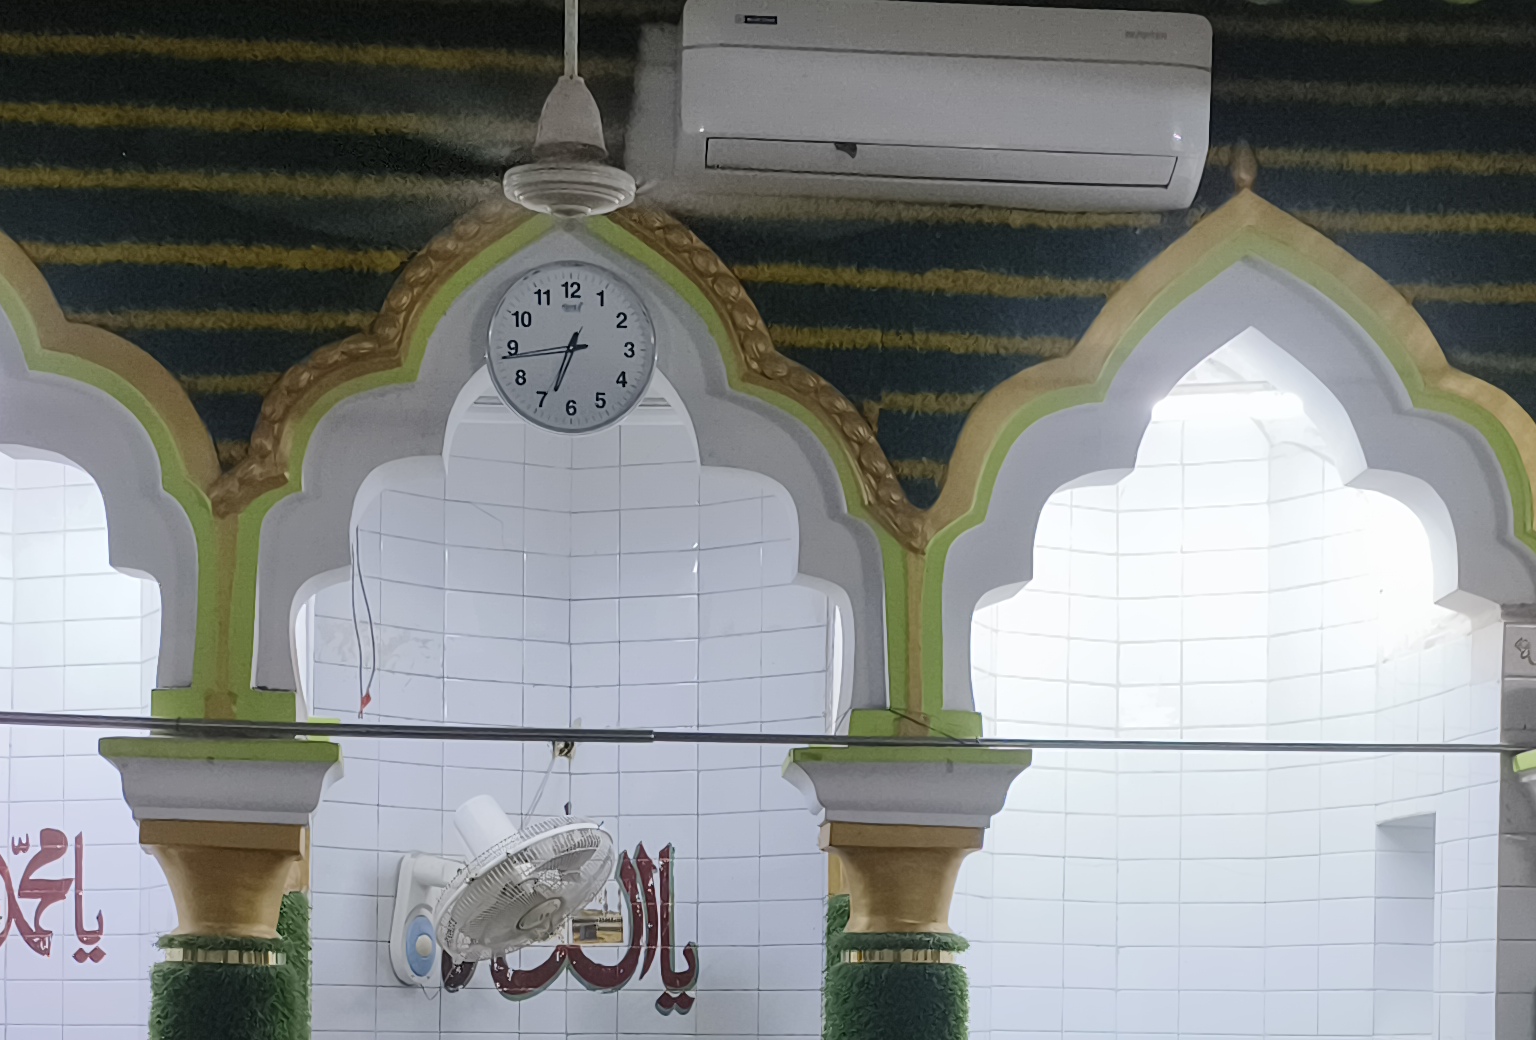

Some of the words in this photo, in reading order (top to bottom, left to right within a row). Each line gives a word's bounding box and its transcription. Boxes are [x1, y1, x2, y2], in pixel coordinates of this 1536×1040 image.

[534, 289, 551, 305] 11
[561, 281, 581, 298] 12
[596, 290, 605, 306] 1
[512, 311, 532, 327] 10
[616, 312, 628, 328] 2
[507, 340, 519, 356] 9
[624, 342, 635, 358] 3
[515, 369, 527, 385] 8
[616, 371, 628, 387] 4
[536, 391, 548, 407] 7
[595, 392, 607, 408] 5
[565, 400, 577, 416] 6
